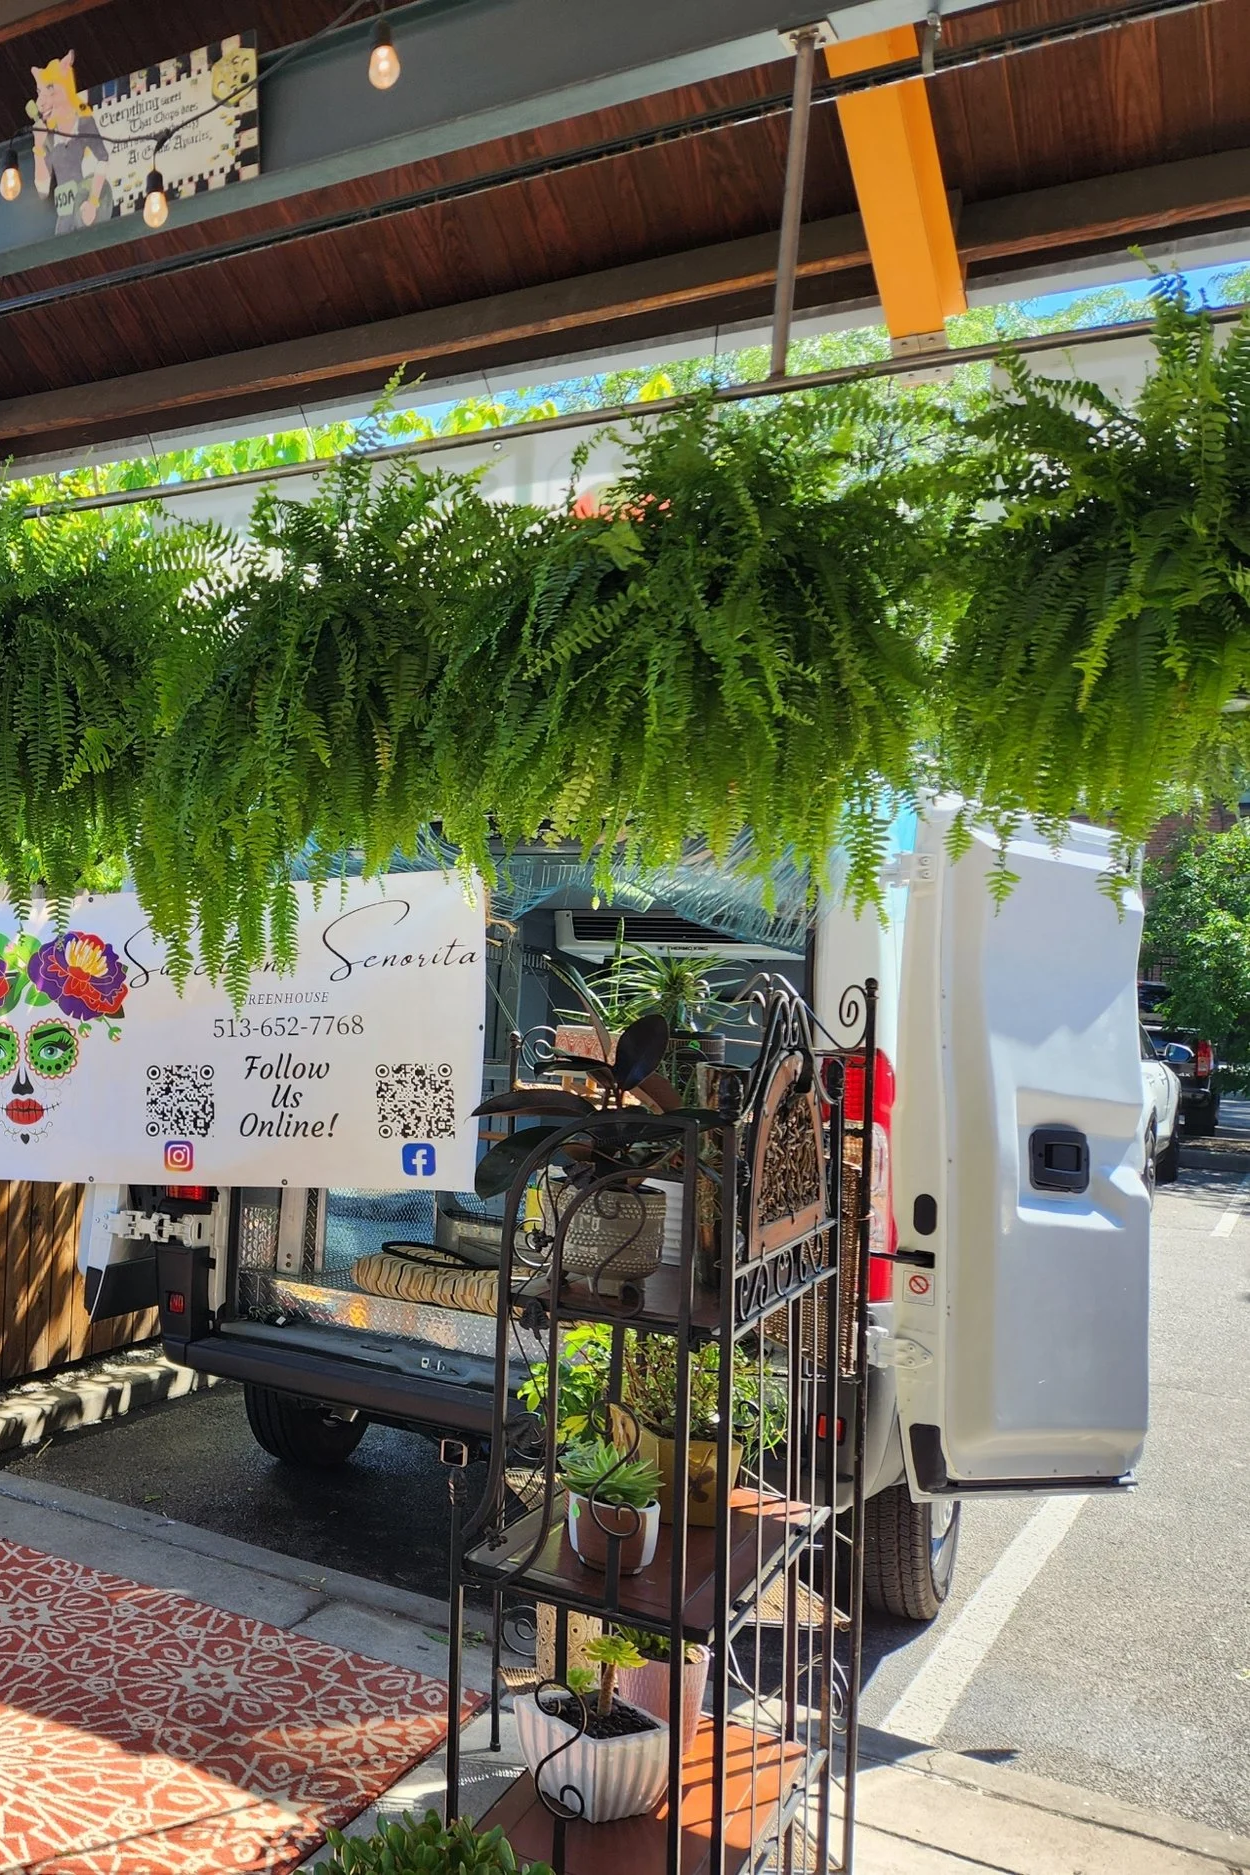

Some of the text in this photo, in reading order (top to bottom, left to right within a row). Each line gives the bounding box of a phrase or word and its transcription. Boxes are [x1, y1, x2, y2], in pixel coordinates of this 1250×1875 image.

[322, 899, 482, 982] Senorita
[212, 1014, 365, 1038] 513-652-7768
[244, 1052, 330, 1080] Follow
[271, 1083, 303, 1109] Us
[239, 1110, 340, 1138] Online!
